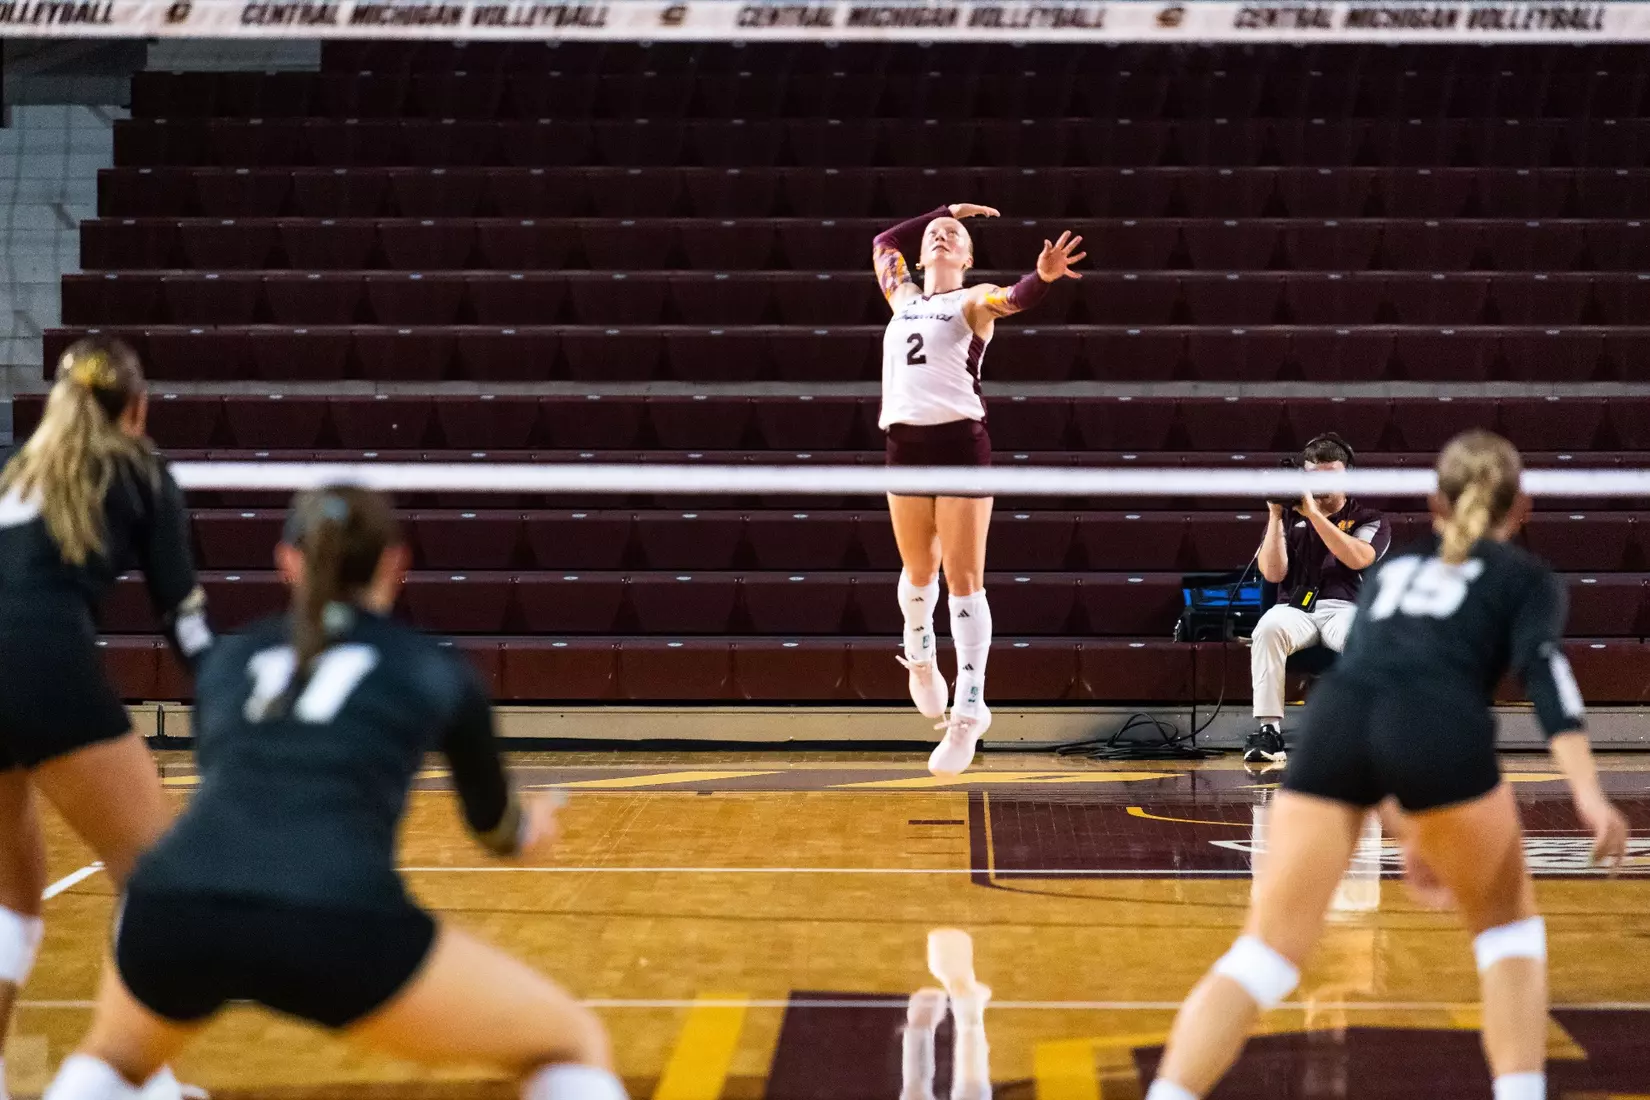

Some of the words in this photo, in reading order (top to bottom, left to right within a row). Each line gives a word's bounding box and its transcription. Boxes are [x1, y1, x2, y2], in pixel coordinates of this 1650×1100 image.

[241, 3, 339, 25] CENTRAL
[349, 4, 464, 26] MICHIGAN
[472, 6, 610, 27] VOLLEYBALL
[737, 6, 836, 27] CENTRAL
[846, 7, 958, 28] MICHIGAN
[967, 7, 1106, 28] VOLLEYBALL
[1234, 8, 1334, 29] CENTRAL
[1345, 8, 1458, 29] MICHIGAN
[1467, 8, 1606, 30] VOLLEYBALL
[907, 333, 927, 365] 2
[1370, 553, 1485, 620] 15
